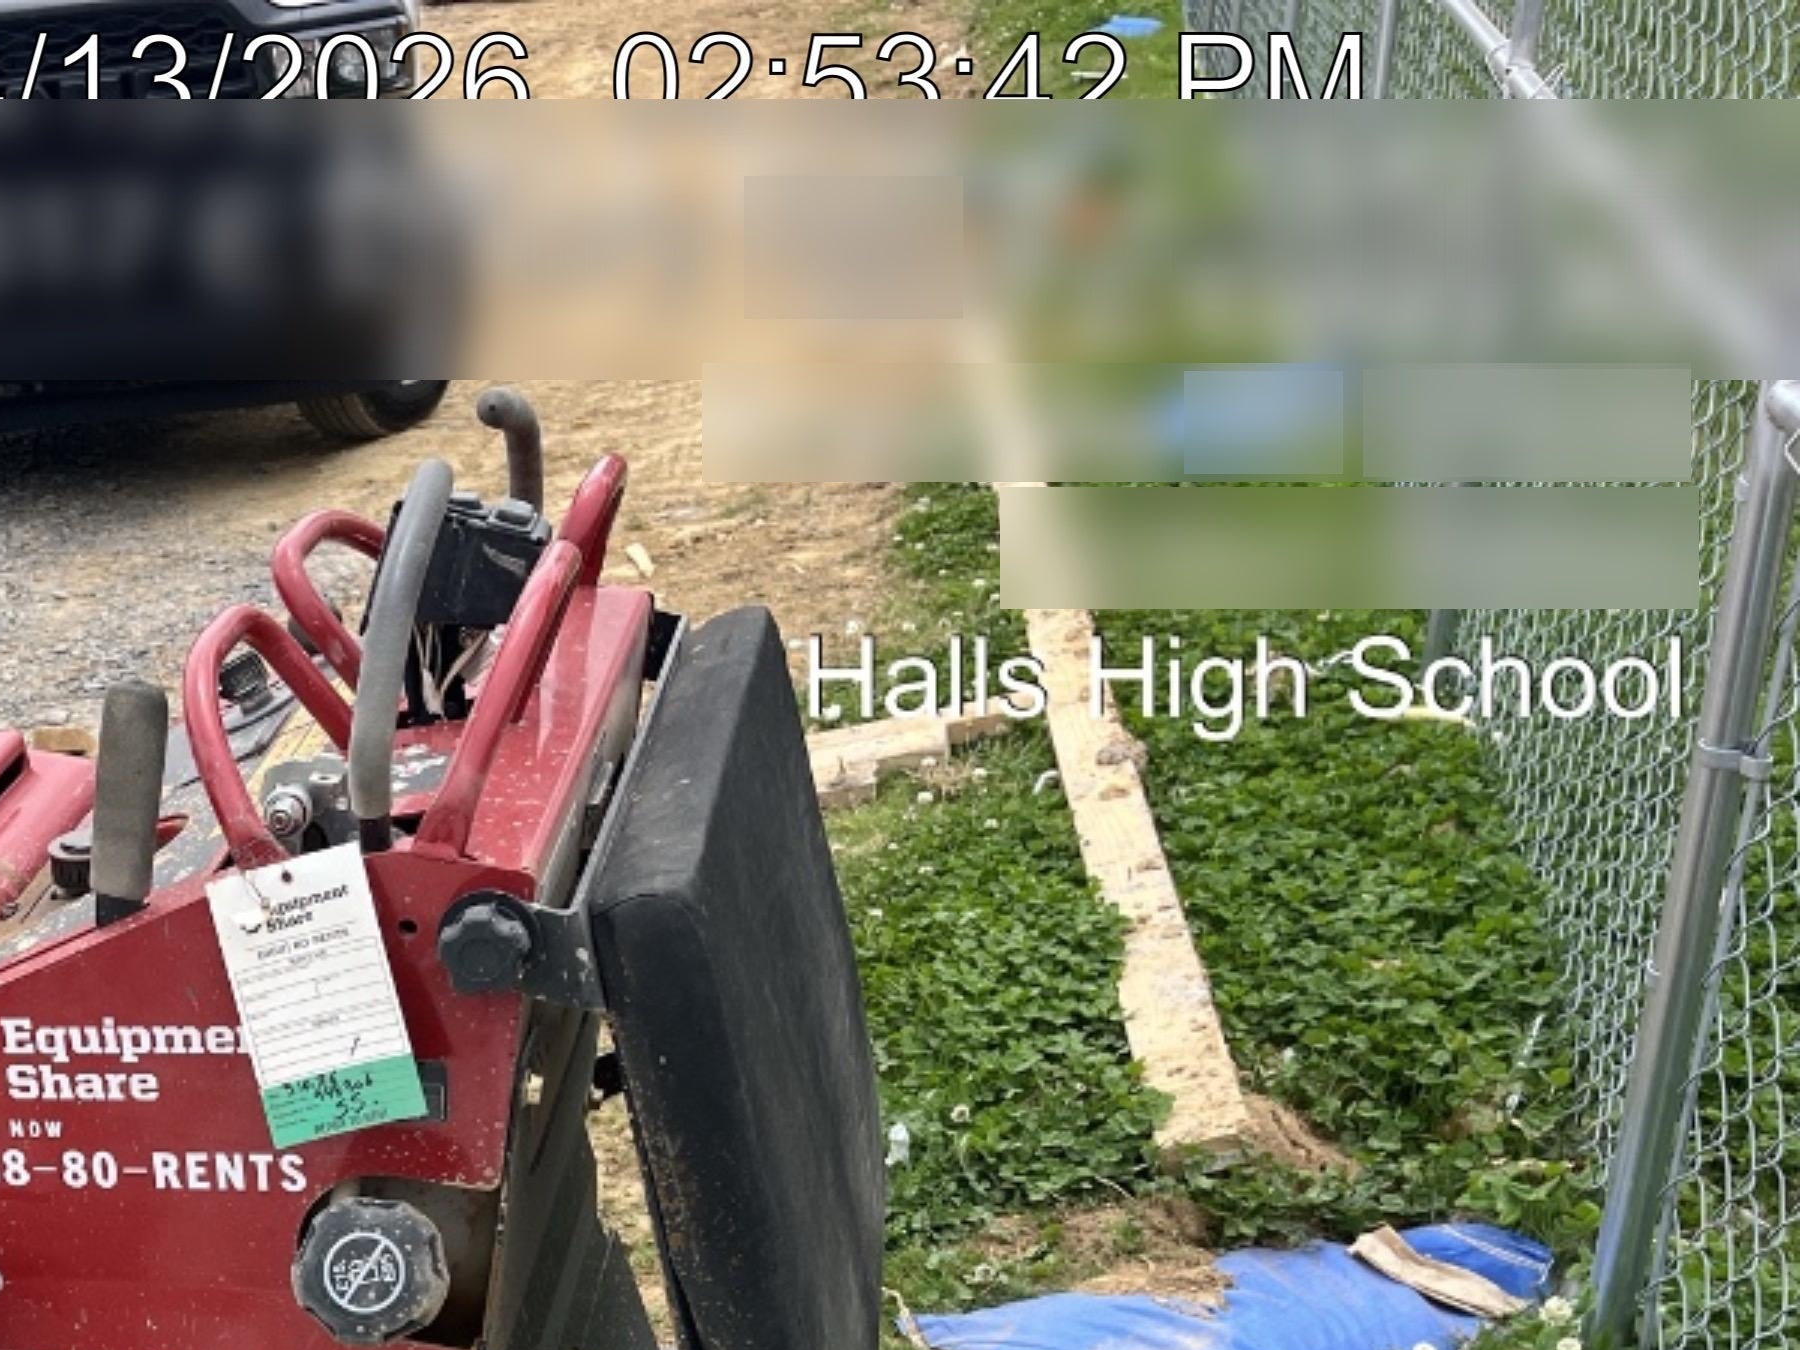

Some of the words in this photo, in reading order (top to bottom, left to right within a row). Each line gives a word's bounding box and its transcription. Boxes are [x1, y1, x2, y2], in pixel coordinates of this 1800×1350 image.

[268, 884, 349, 917] quipment
[0, 1016, 250, 1063] Equipme
[5, 1062, 160, 1101] Share
[9, 1119, 63, 1138] NOW
